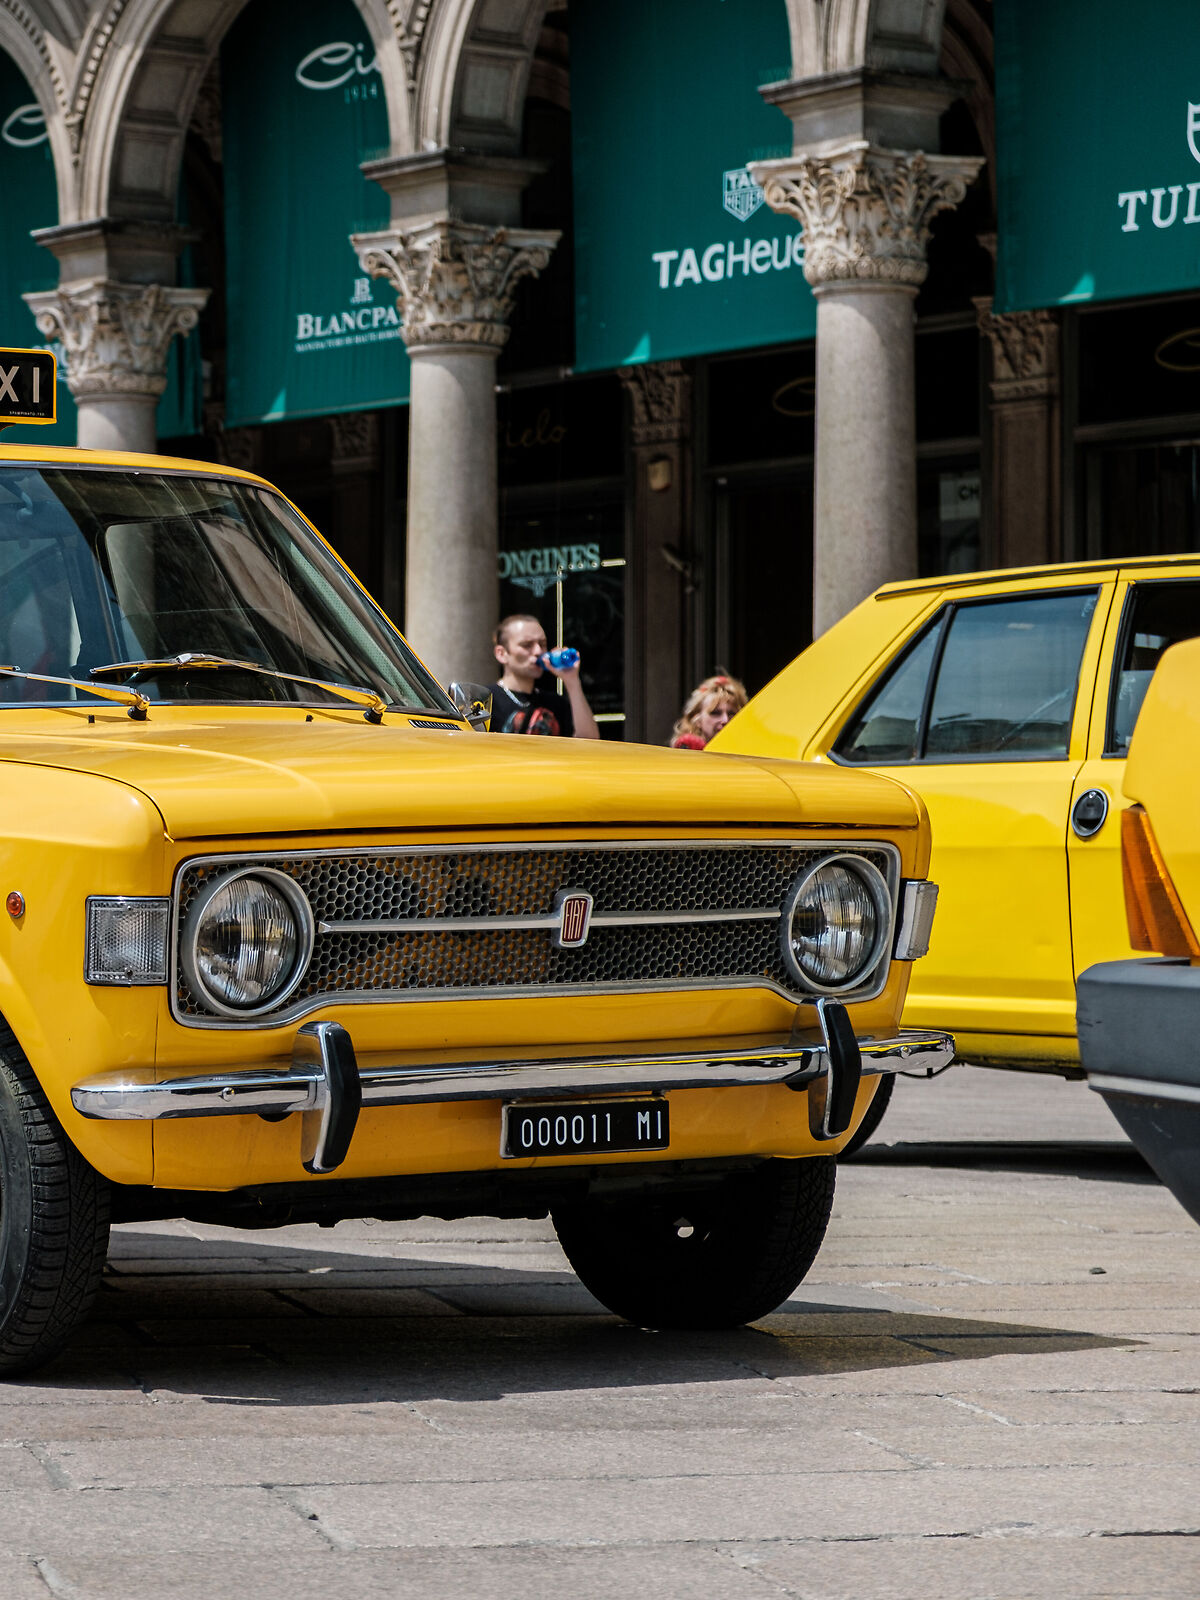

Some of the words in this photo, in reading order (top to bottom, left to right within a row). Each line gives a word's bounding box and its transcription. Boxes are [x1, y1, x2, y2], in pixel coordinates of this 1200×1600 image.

[652, 231, 806, 289] TAGHeue
[296, 305, 403, 340] BLANCPA
[498, 543, 600, 579] ONGINES
[563, 899, 586, 940] FIAT
[521, 1112, 611, 1149] 000011
